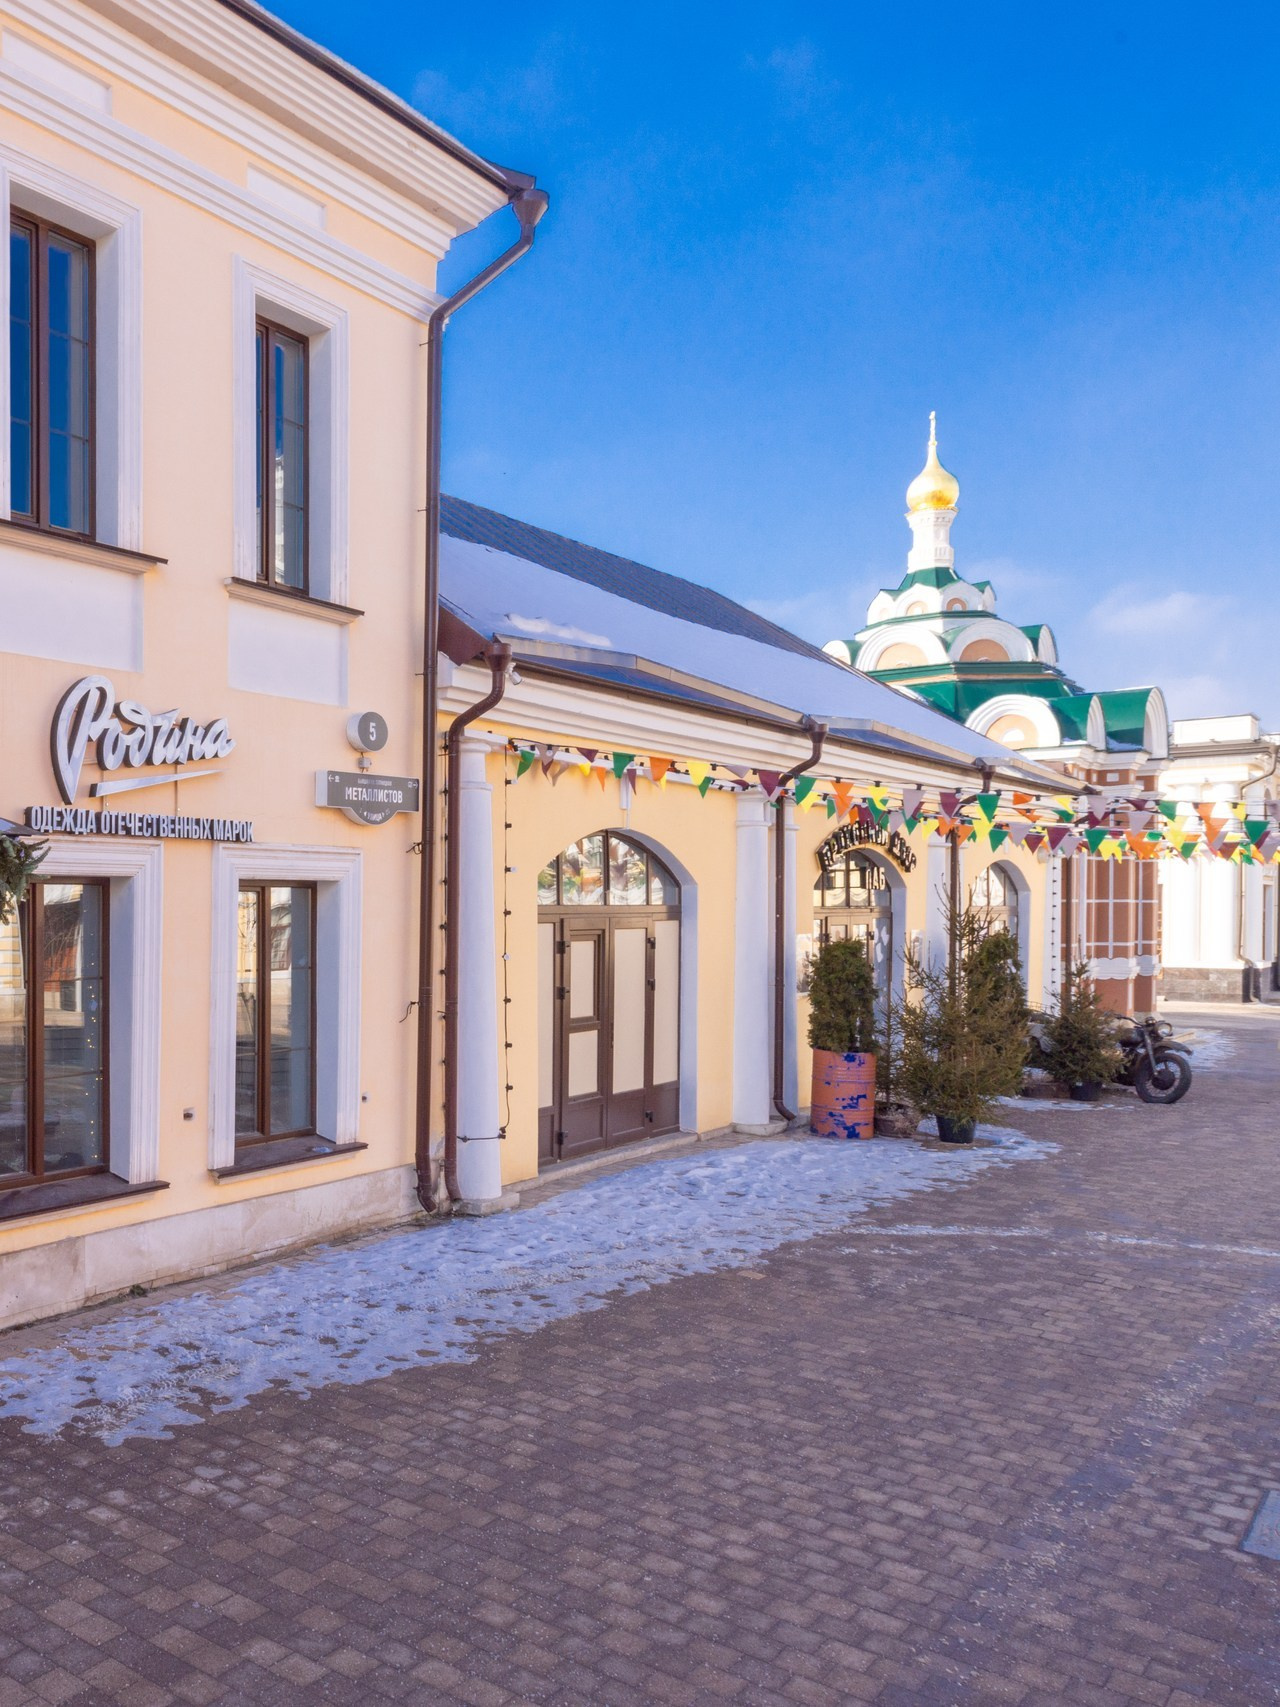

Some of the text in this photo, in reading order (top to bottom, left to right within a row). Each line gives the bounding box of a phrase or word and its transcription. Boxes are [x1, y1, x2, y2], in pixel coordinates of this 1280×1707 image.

[50, 674, 236, 805] Родина
[369, 721, 376, 741] 5
[345, 786, 403, 803] МЕТАЛЛИСТОВ
[30, 806, 254, 843] ОДЕЖДА ОТЕЧЕСТВЕННЫХ МАРОК
[866, 867, 885, 891] ПАБ
